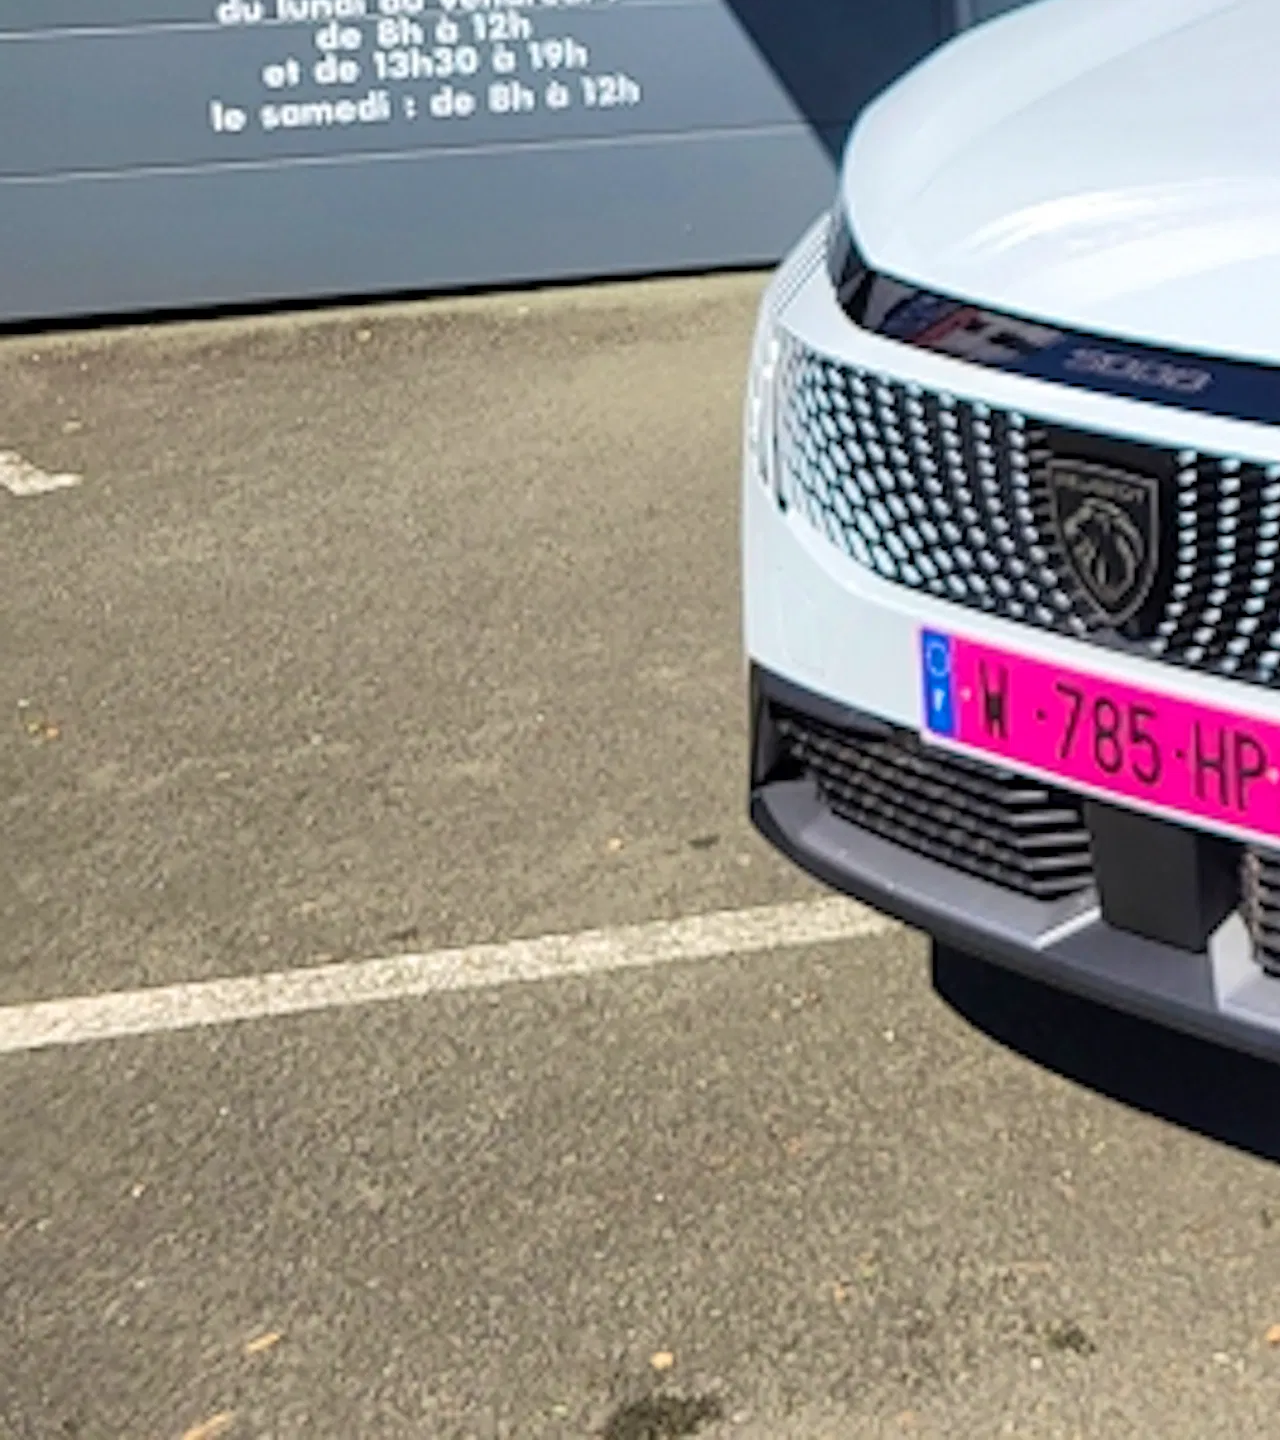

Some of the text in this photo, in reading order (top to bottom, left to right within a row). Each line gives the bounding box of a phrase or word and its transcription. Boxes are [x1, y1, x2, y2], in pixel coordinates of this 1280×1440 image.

[314, 12, 533, 53] de 8h à 12h
[261, 37, 590, 89] et de 13h30 à 19h
[210, 100, 248, 134] le
[259, 89, 392, 131] samedi
[429, 85, 477, 119] de
[487, 81, 535, 114] 8h
[544, 80, 570, 109] à
[580, 72, 642, 108] 12h
